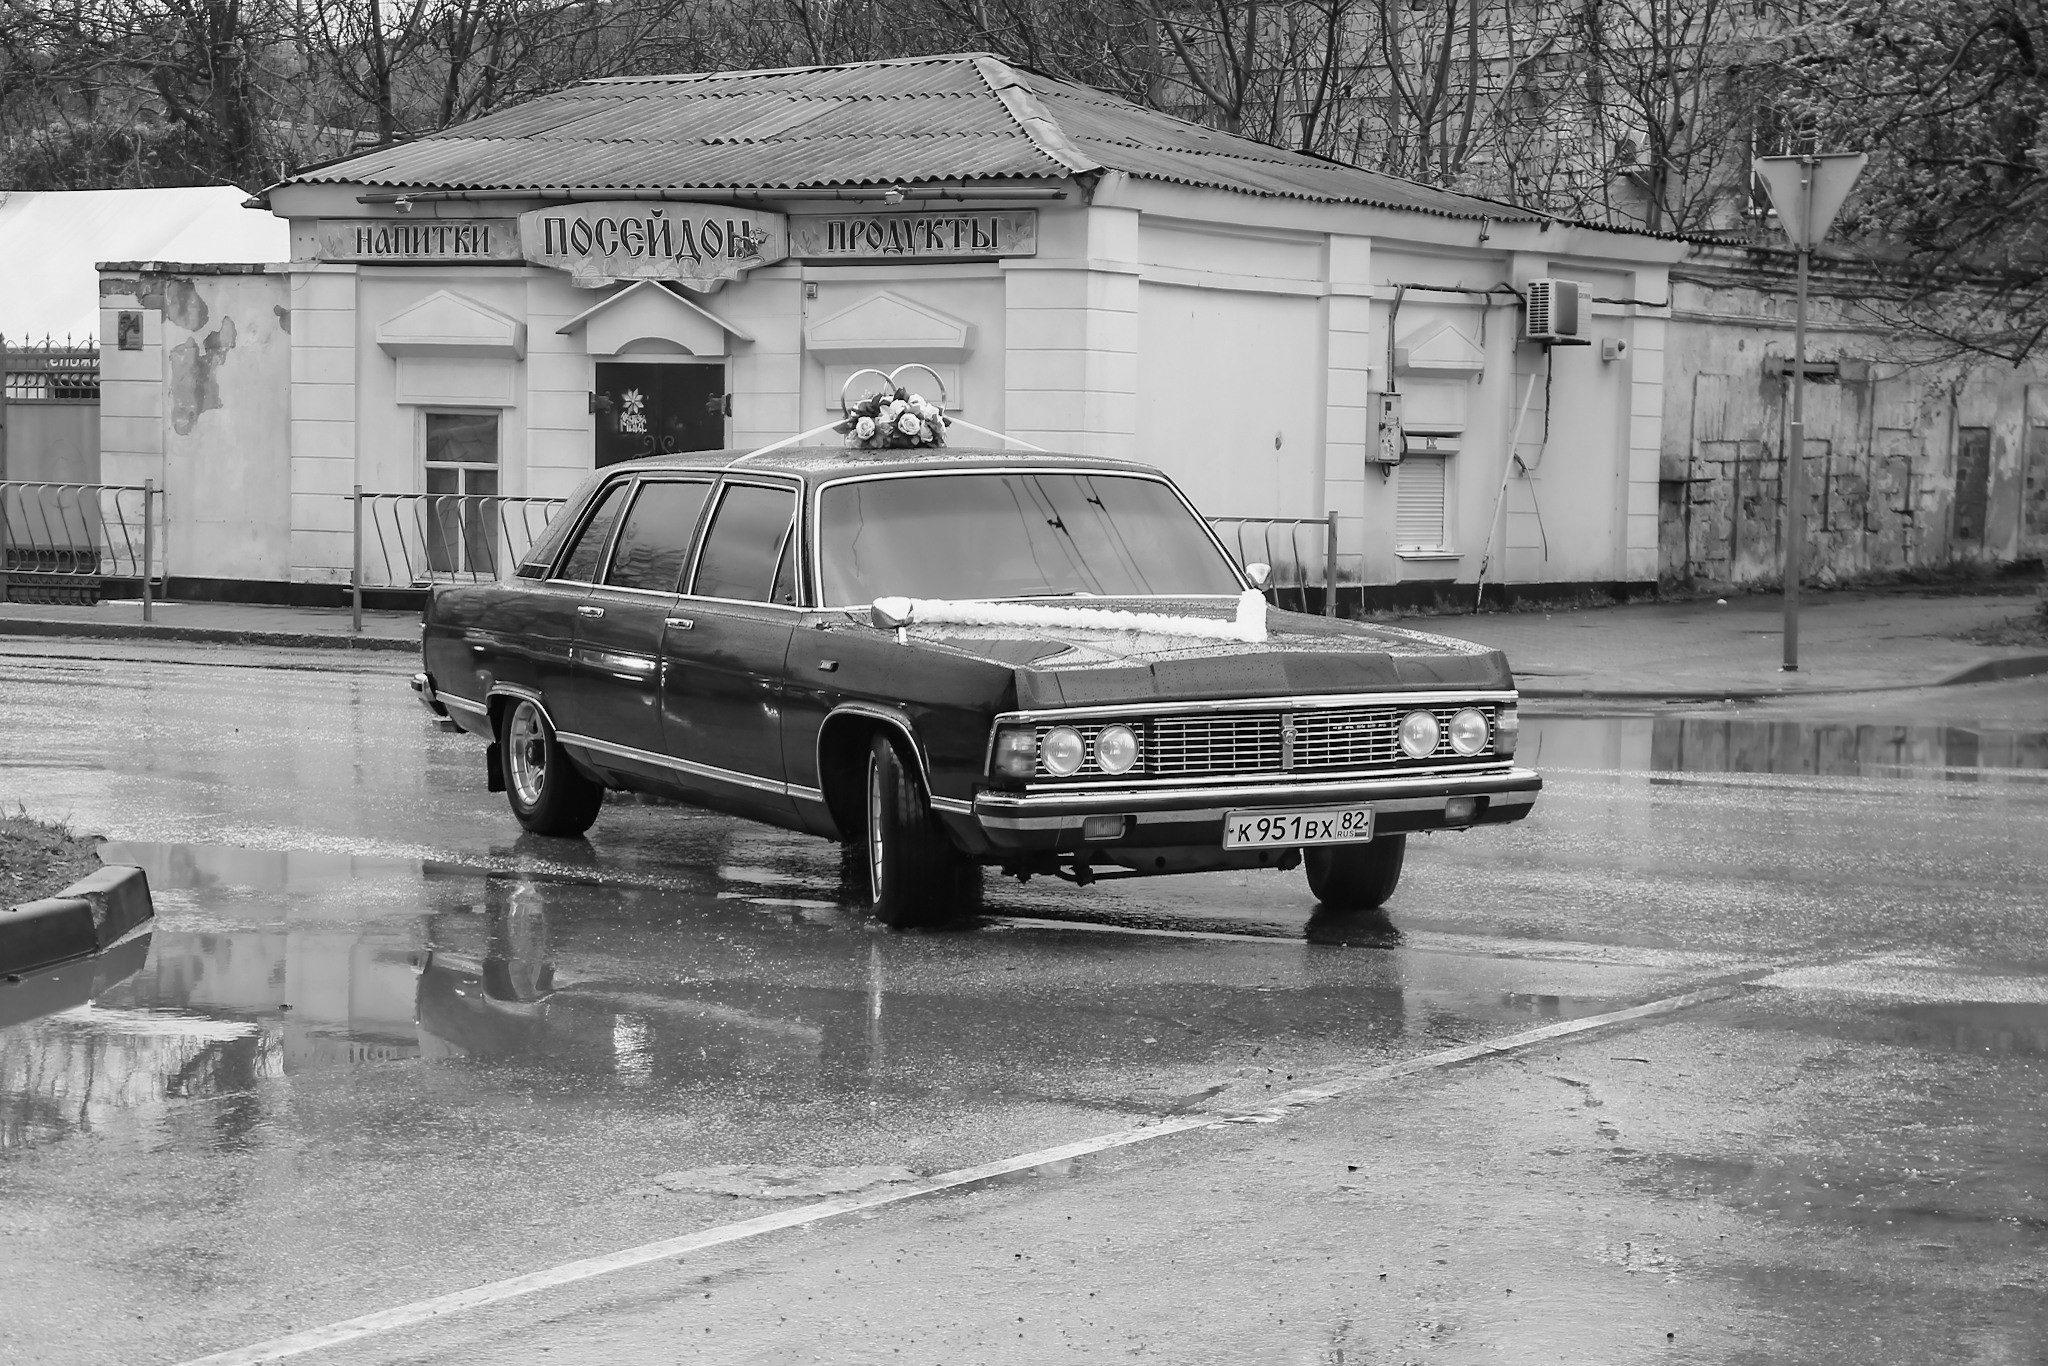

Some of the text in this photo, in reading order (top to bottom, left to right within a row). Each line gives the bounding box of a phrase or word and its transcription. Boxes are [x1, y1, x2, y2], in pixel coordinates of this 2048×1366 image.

[356, 224, 490, 255] НАПИТКИ
[543, 208, 752, 267] ПОСЕЙДОН
[827, 216, 1000, 255] ПРОДУКТЫ
[1337, 829, 1355, 838] RUS
[1342, 811, 1365, 830] 82
